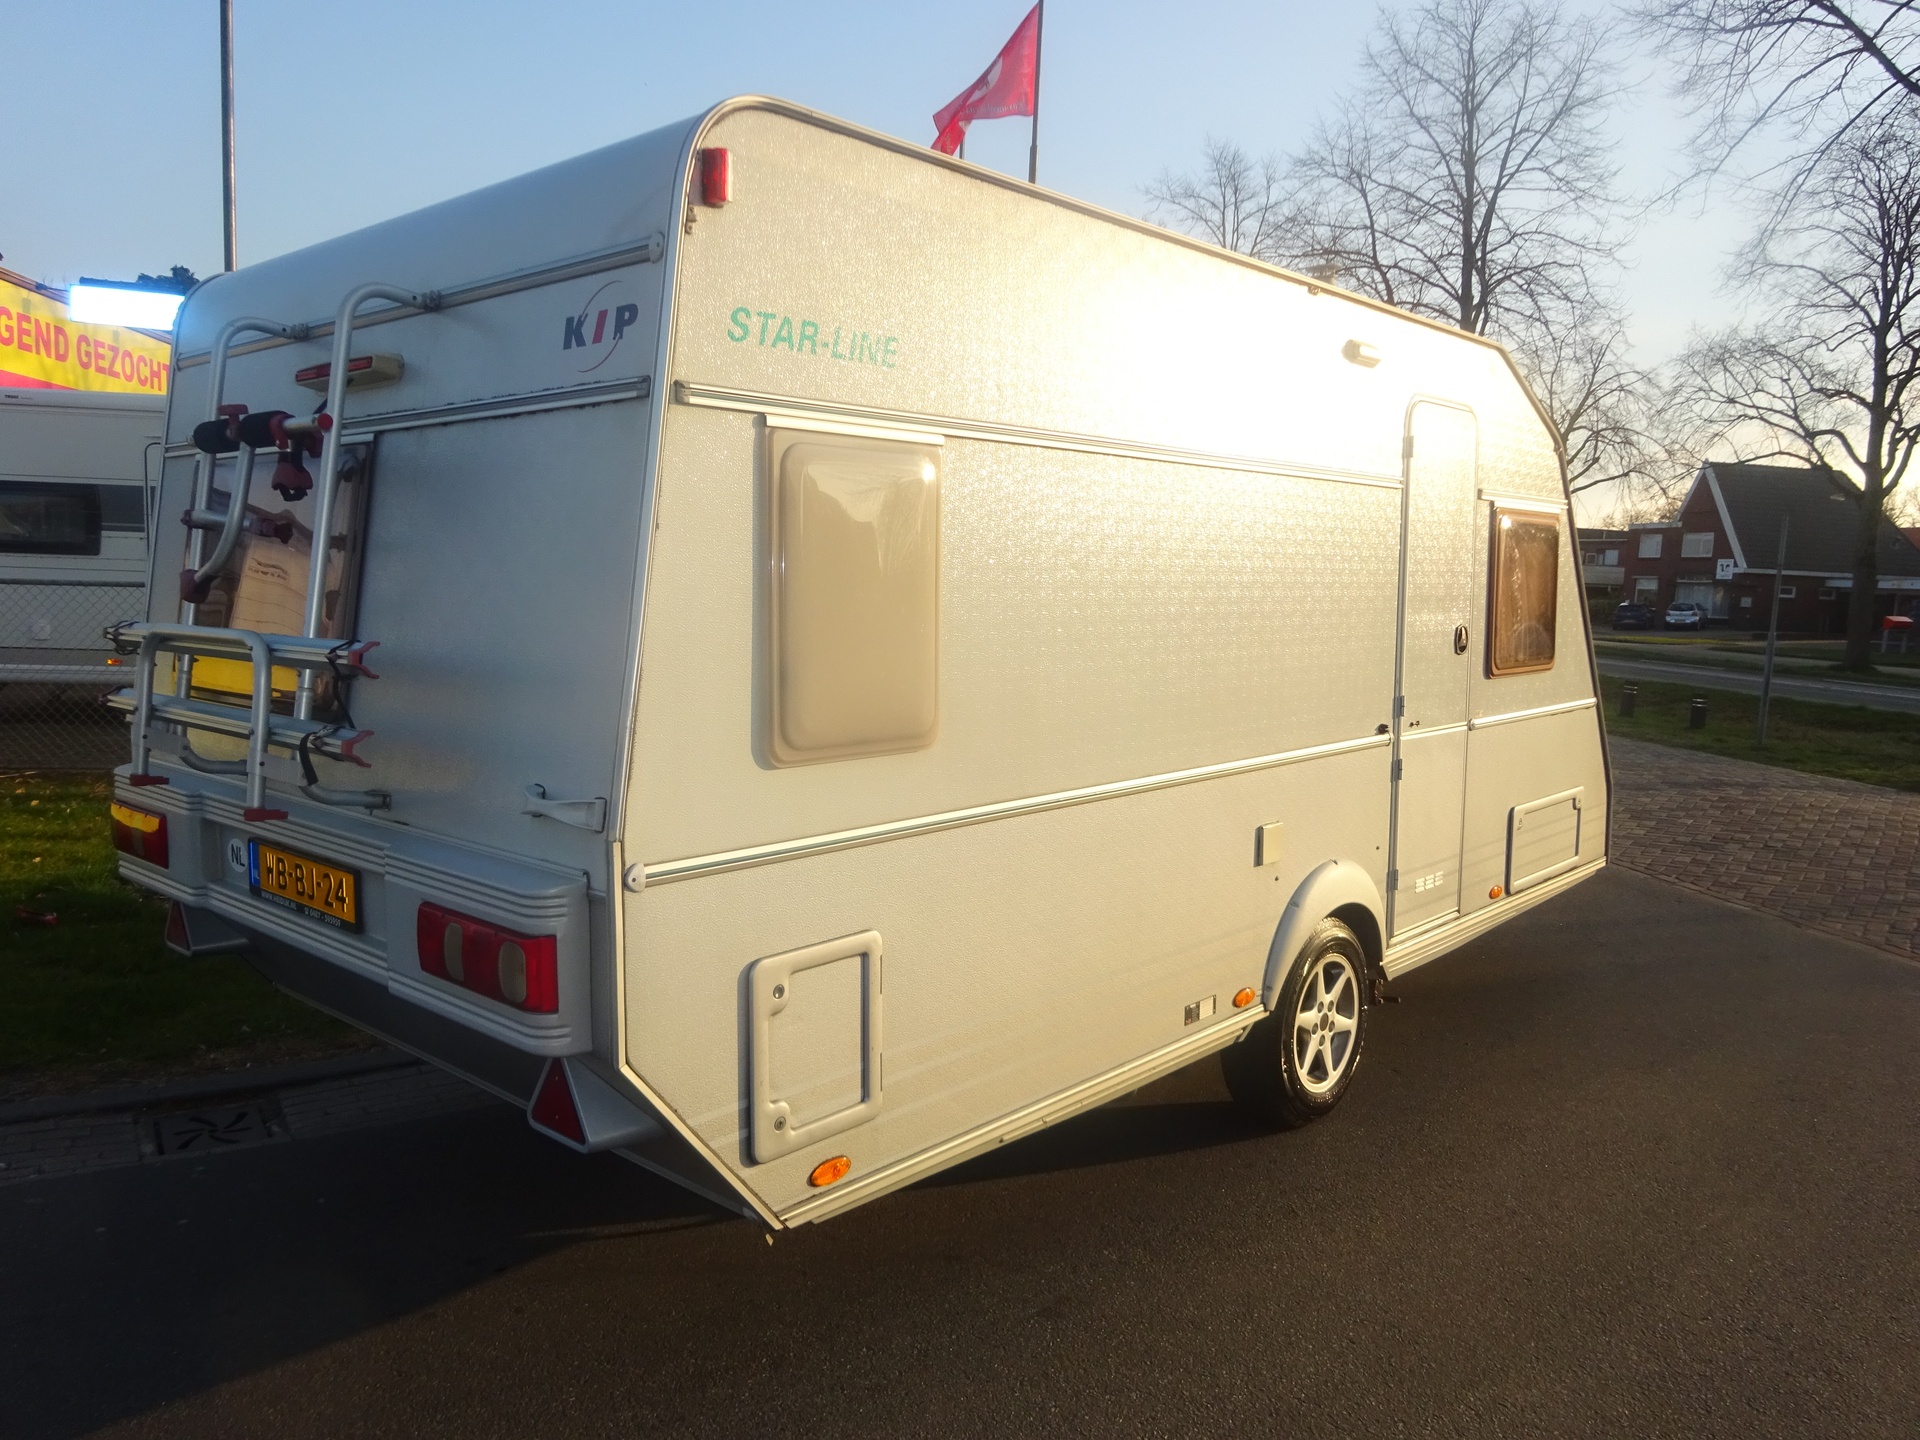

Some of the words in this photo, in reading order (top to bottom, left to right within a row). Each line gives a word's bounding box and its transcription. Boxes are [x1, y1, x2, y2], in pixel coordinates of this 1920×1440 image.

[563, 303, 639, 351] KIP
[727, 306, 899, 369] STAR-LINE
[231, 843, 246, 867] NL
[266, 852, 349, 913] WB-BJ-24
